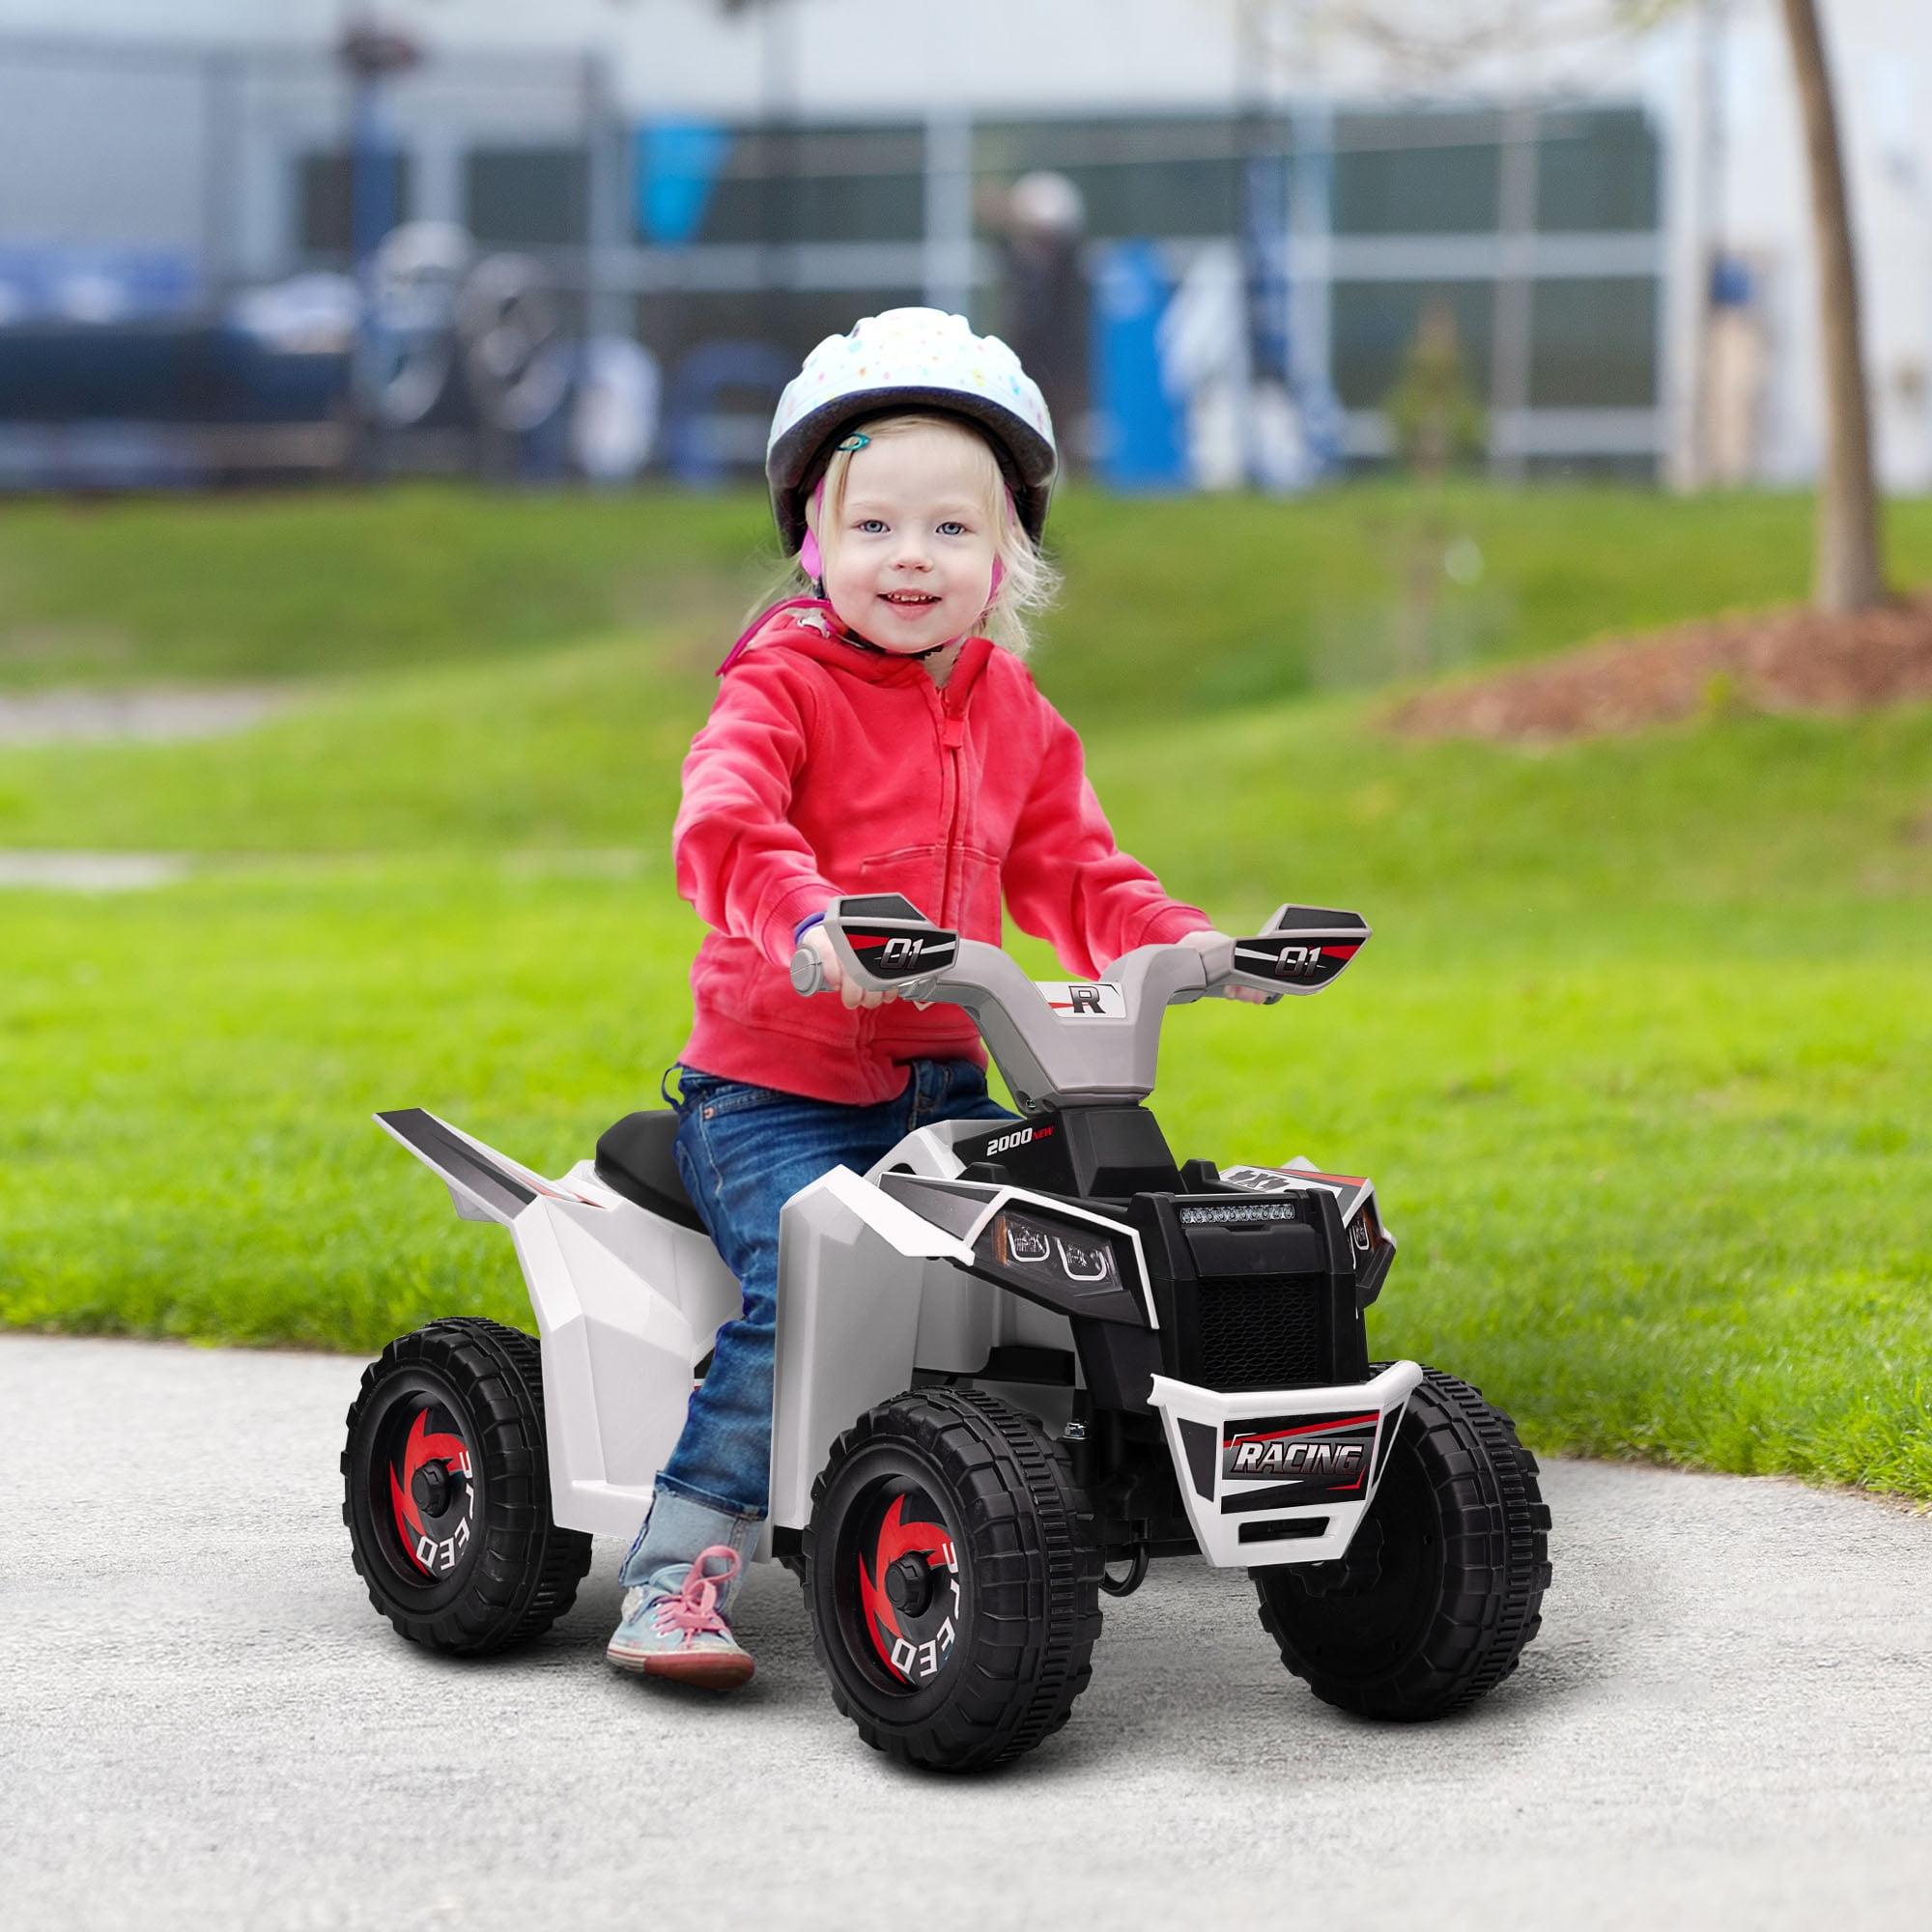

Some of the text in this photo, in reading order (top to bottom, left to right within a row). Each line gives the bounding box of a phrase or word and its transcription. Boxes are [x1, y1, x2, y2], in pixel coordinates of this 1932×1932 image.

[880, 937, 924, 970] 01
[1275, 946, 1322, 977] 01
[1067, 985, 1107, 1014] R
[986, 1126, 1033, 1156] 2000
[1231, 1441, 1364, 1475] RACING
